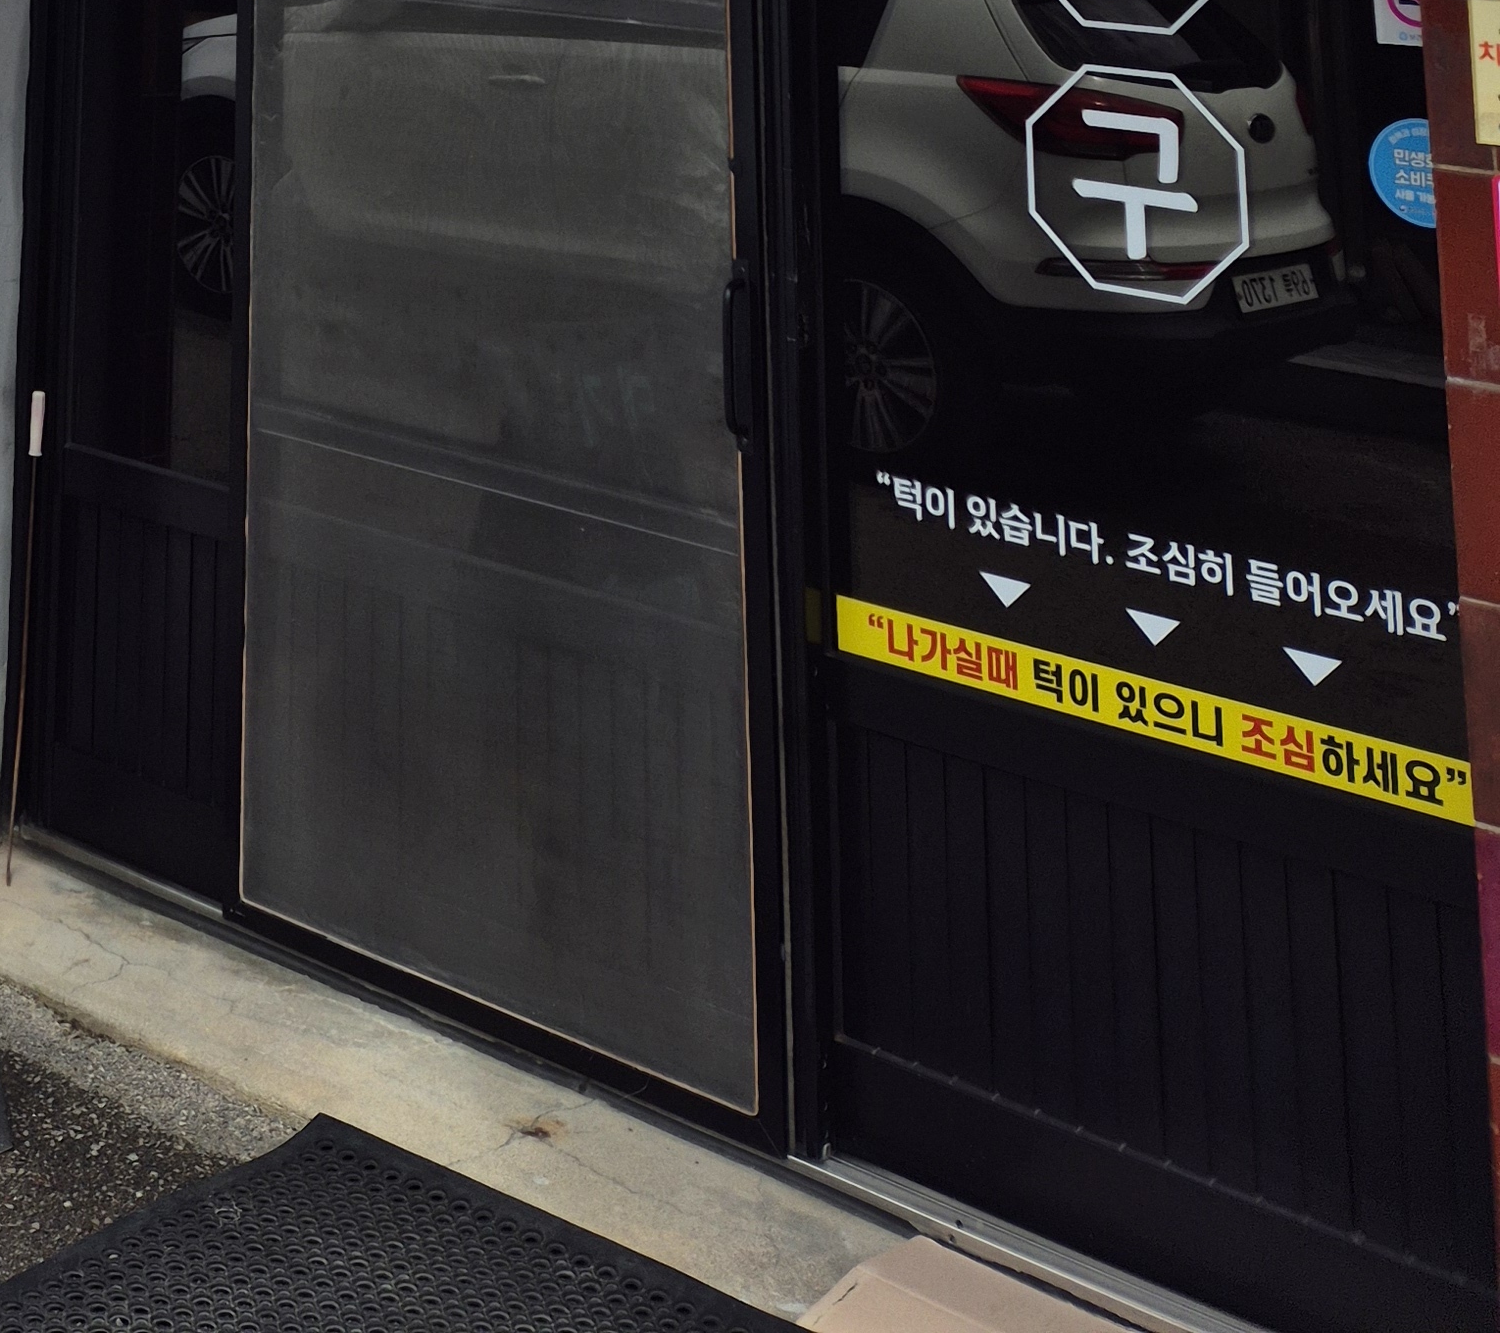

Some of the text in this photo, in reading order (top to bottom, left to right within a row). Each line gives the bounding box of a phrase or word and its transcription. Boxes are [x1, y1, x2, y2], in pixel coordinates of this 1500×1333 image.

[965, 493, 1115, 566] 있습니다.
[1124, 532, 1235, 597] 조심히
[1032, 656, 1100, 714] 턱이
[1114, 680, 1224, 748] 있으니
